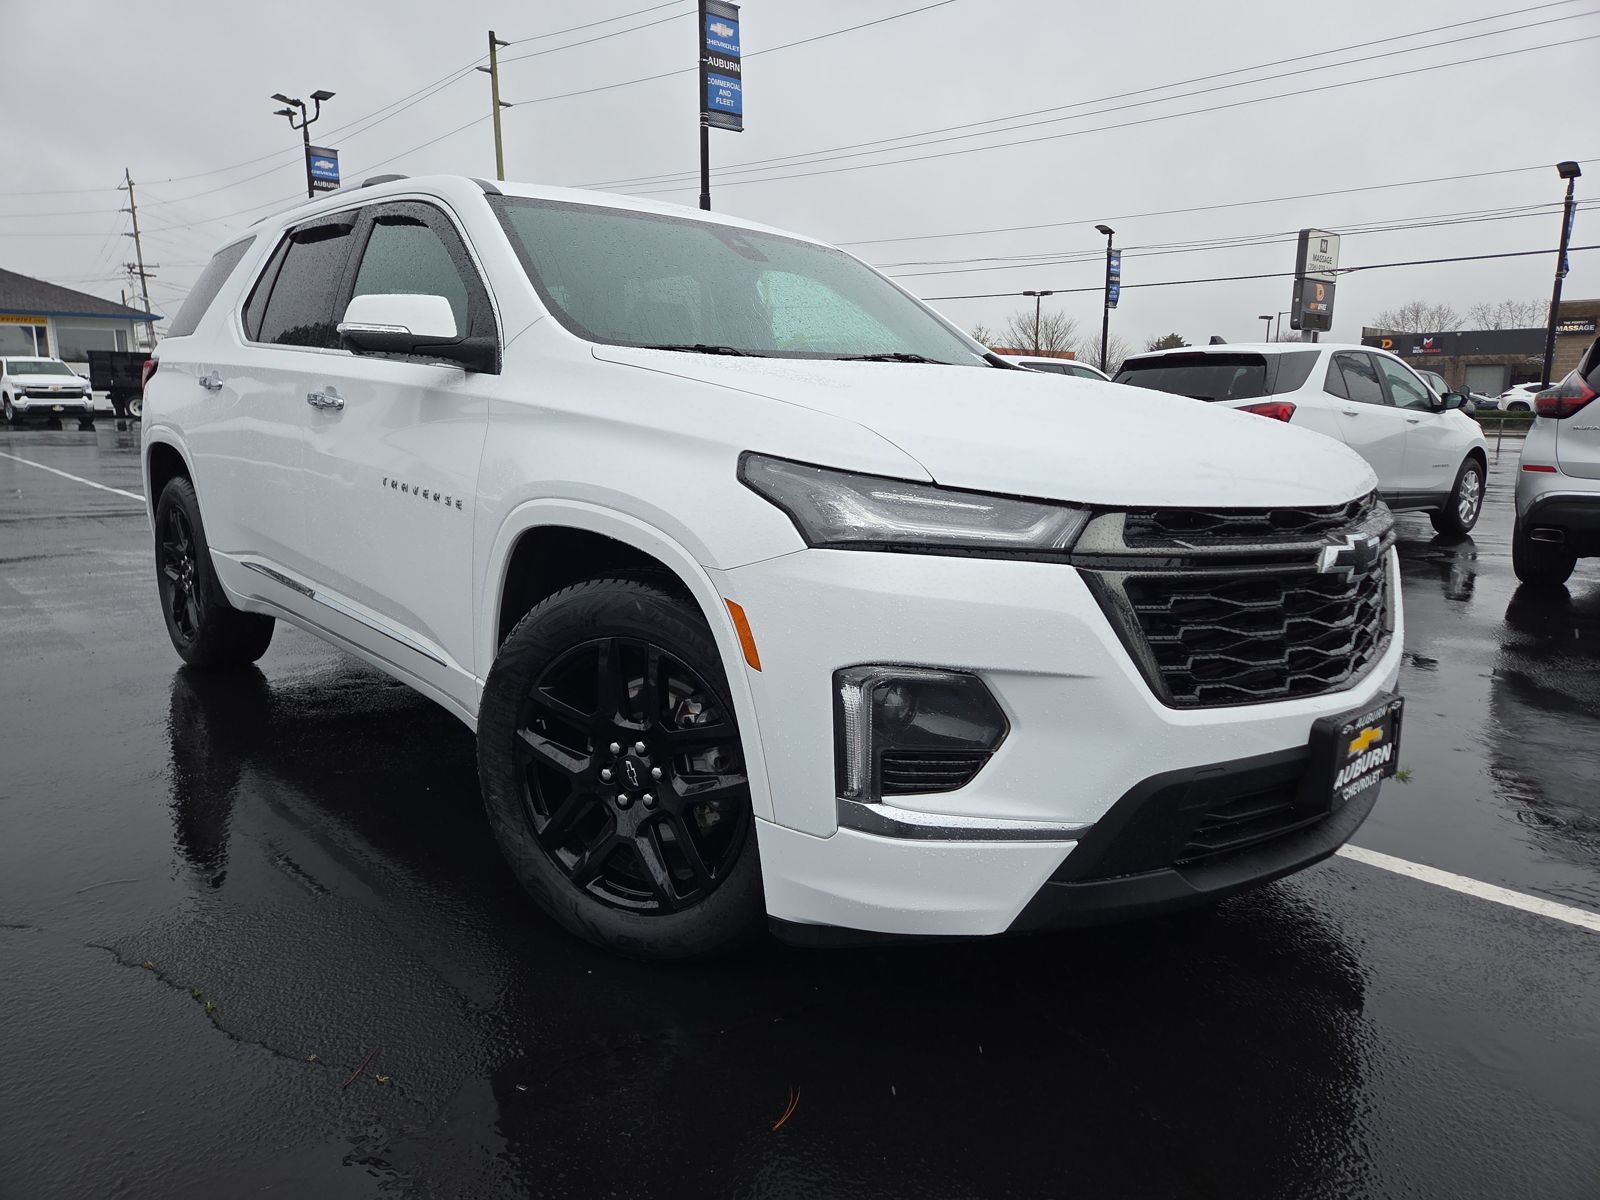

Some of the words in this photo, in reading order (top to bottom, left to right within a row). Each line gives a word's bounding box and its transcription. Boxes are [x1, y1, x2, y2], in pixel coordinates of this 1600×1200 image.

[707, 56, 741, 72] AUBURN
[707, 77, 741, 91] COMMERCIAL
[718, 88, 732, 97] AND
[715, 97, 735, 107] FLEET
[313, 180, 340, 189] AUBURN
[1555, 324, 1595, 332] MASSAGE
[382, 476, 463, 511] TRAVERSE
[1355, 705, 1389, 730] AUBURN
[1333, 742, 1393, 790] AUBURN
[1342, 770, 1382, 801] CHEVROLET
